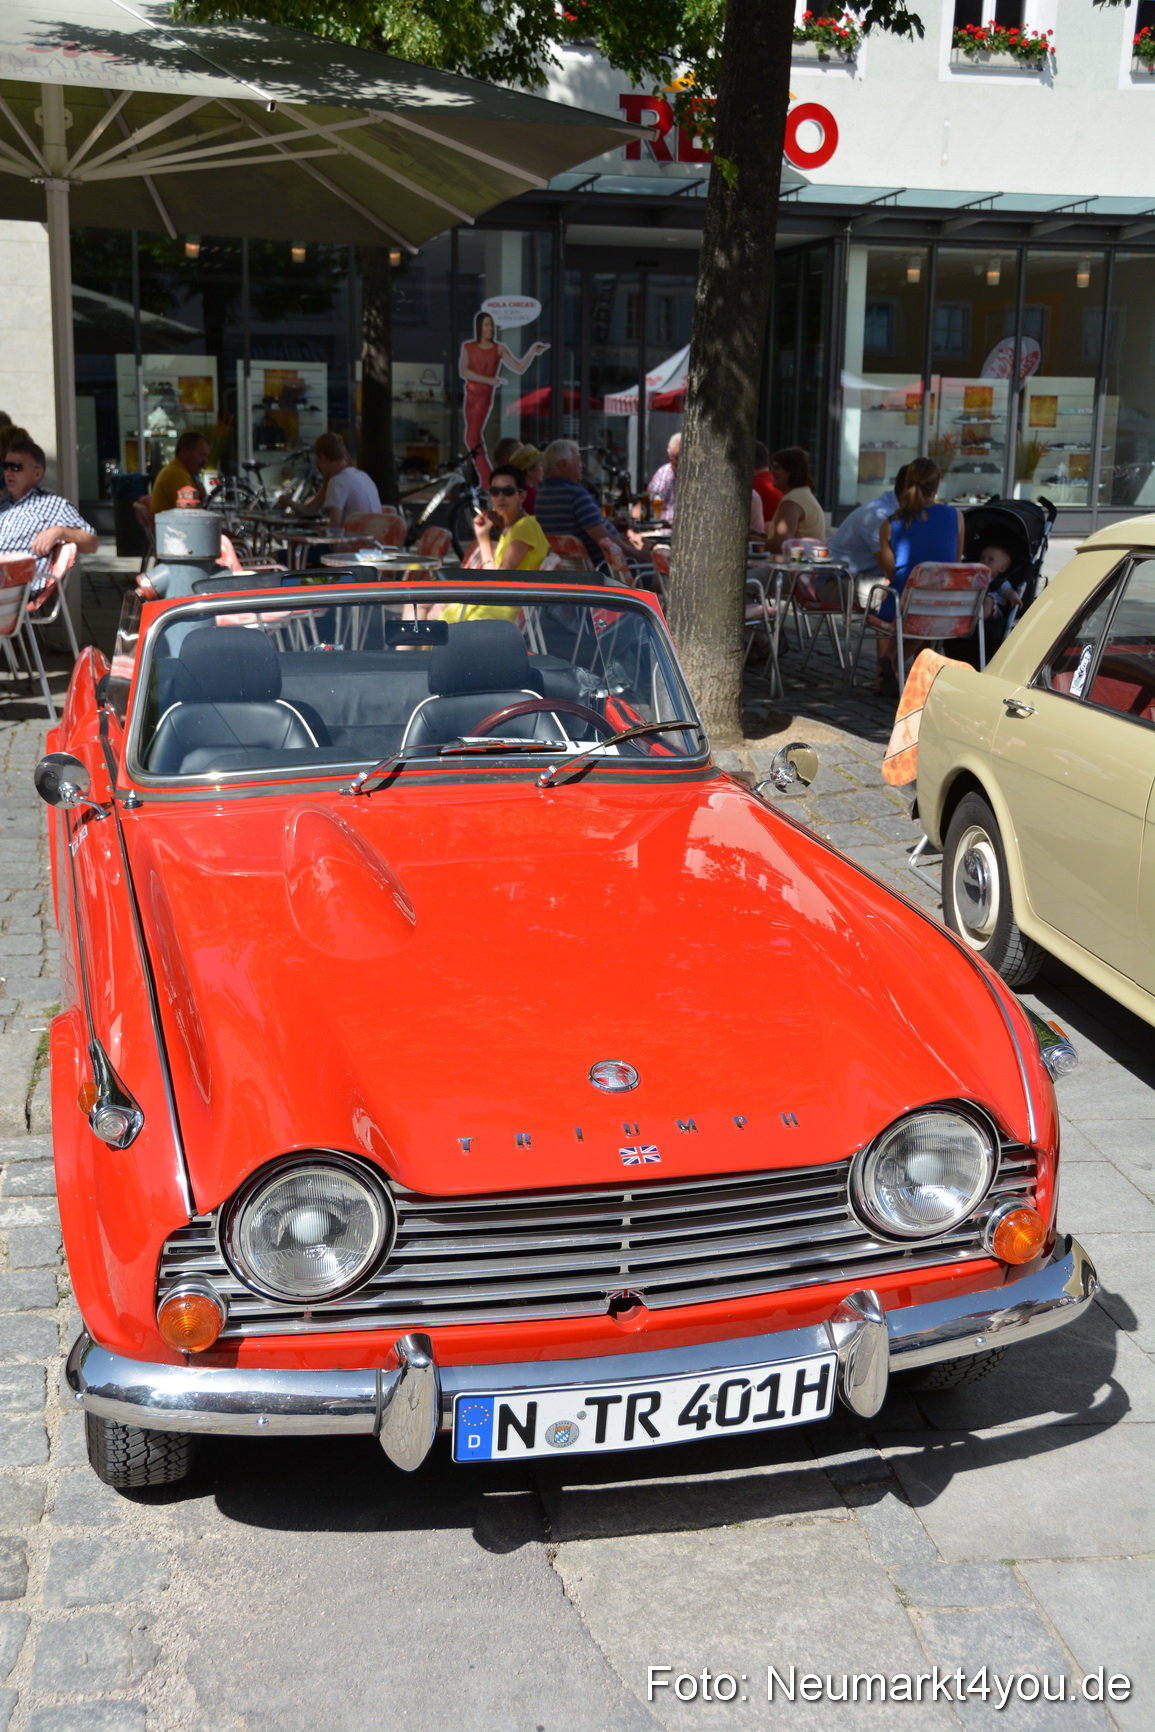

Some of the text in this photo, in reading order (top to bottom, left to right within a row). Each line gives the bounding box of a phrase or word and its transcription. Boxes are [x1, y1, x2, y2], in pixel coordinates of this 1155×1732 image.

[619, 93, 839, 170] REO
[458, 1111, 800, 1154] TRIUMPH
[497, 1363, 831, 1452] N TR 401H
[467, 1433, 481, 1449] D
